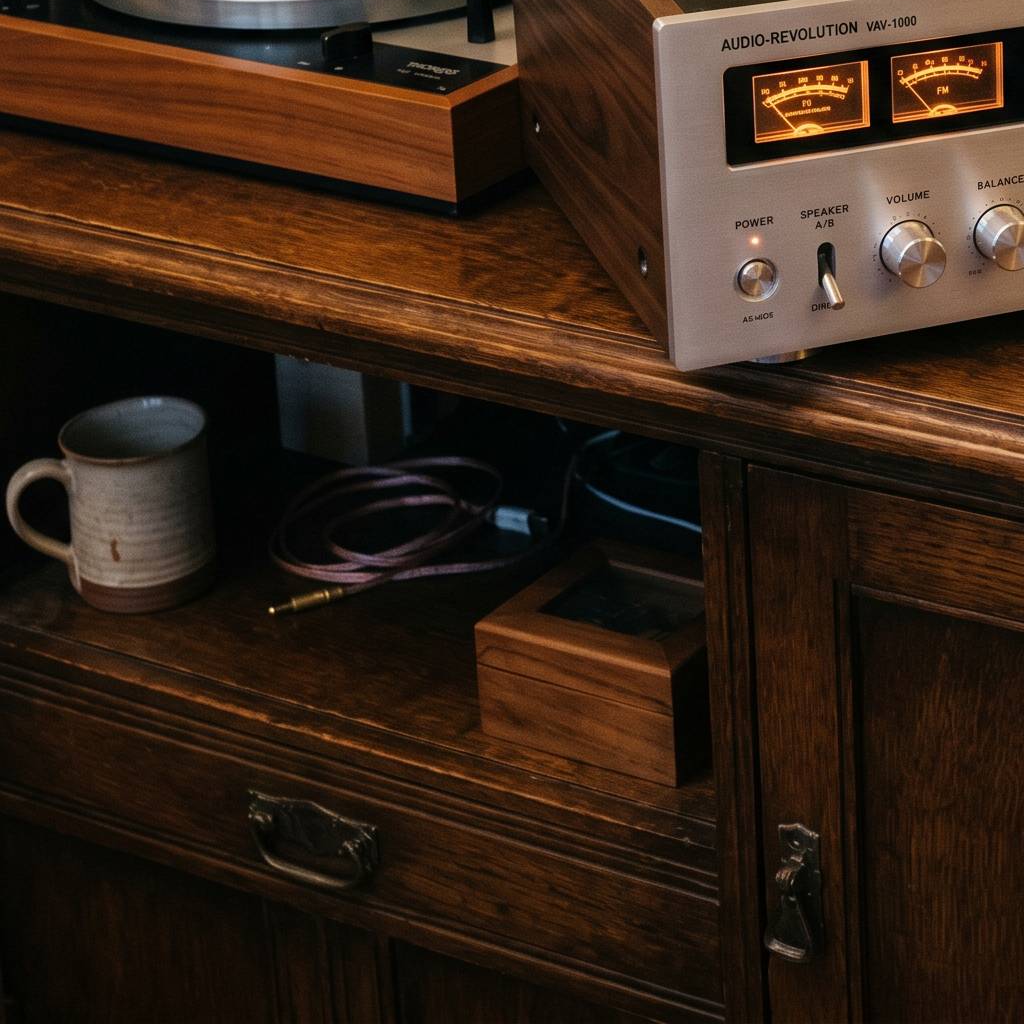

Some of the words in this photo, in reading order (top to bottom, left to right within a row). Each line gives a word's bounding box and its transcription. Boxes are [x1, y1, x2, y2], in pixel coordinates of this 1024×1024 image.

[720, 21, 858, 52] AUDIO-REVOLUTION
[866, 15, 917, 33] VAV-1000
[936, 85, 949, 96] FM
[977, 174, 1024, 190] BALANCE
[886, 190, 931, 205] VOLUME
[800, 204, 849, 220] SPEAKER
[735, 215, 774, 230] POWER
[815, 218, 835, 230] A/B
